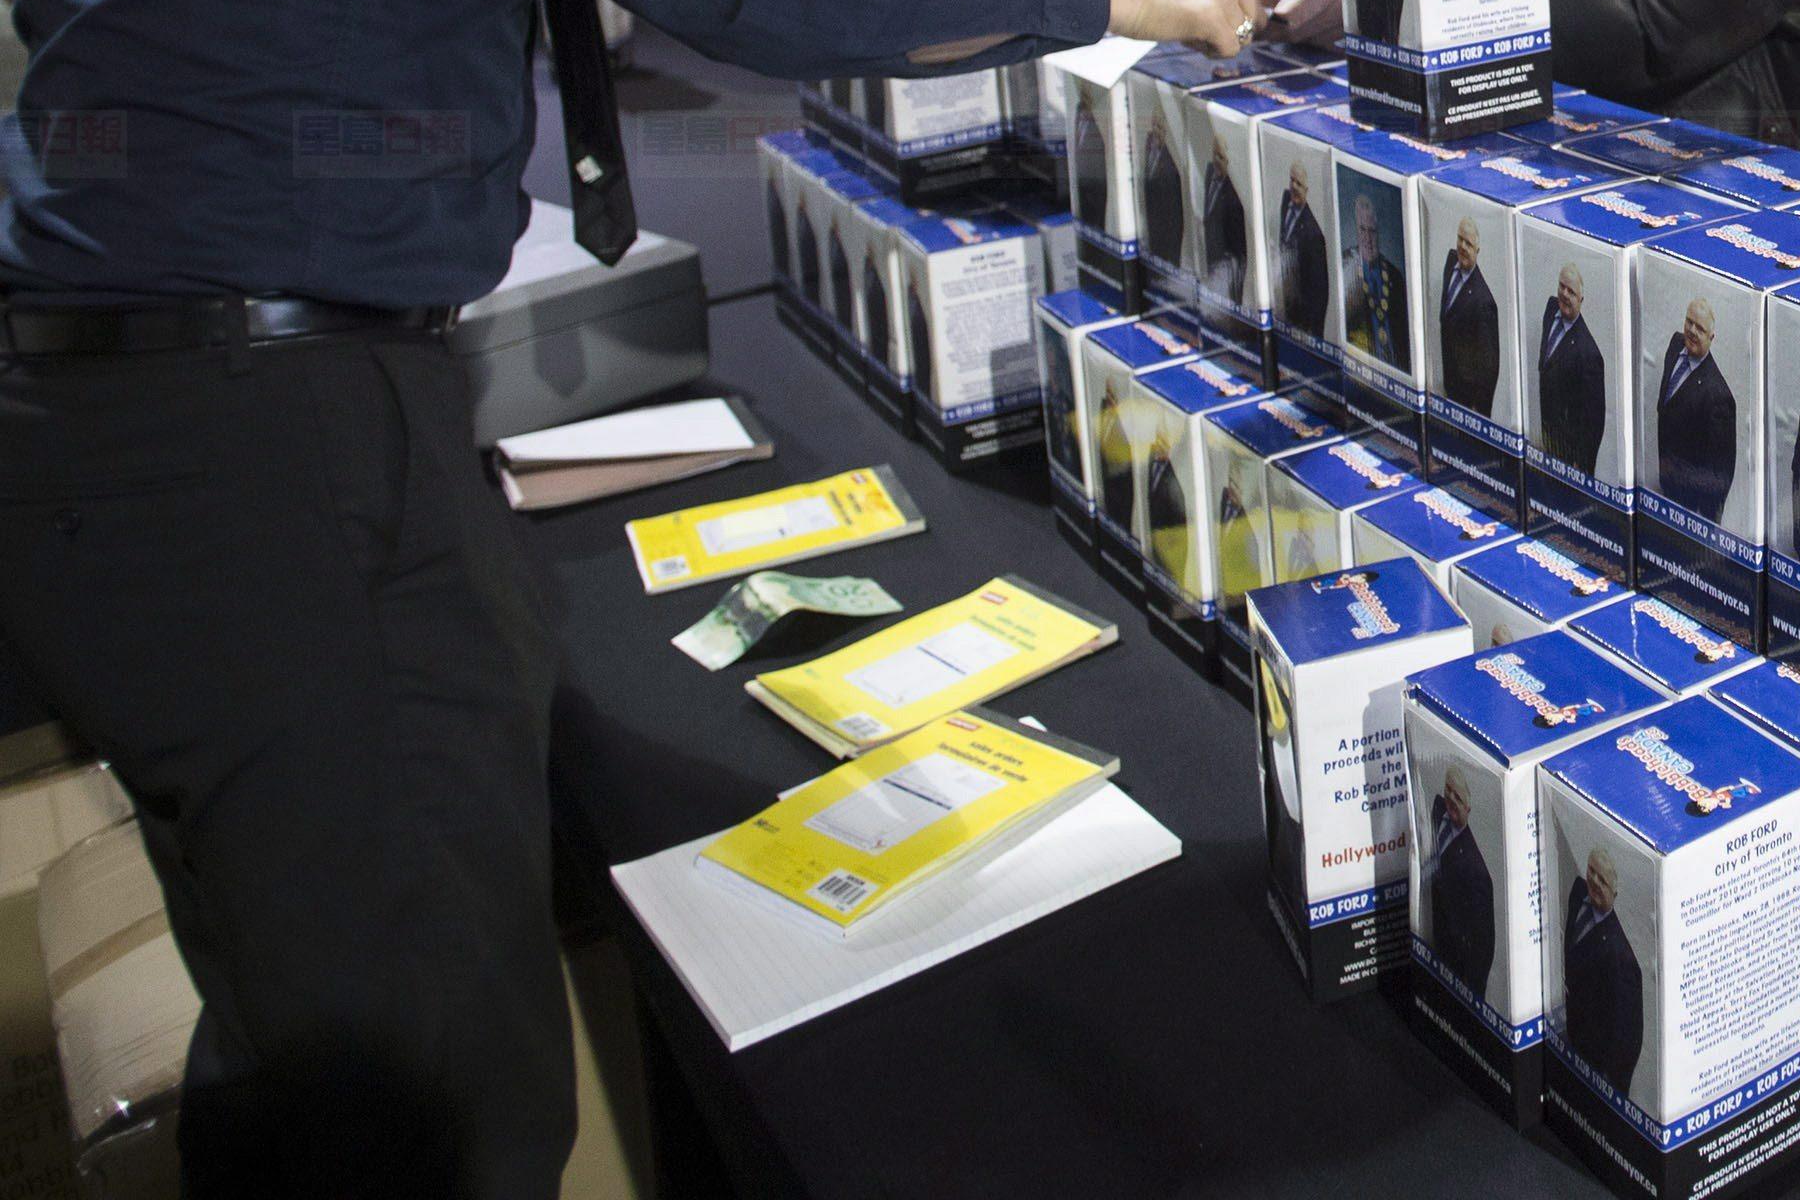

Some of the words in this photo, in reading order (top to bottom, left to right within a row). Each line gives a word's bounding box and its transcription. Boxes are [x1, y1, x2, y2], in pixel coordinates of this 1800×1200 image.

[1440, 49, 1458, 64] ROB
[1460, 45, 1483, 61] FORD
[1494, 39, 1511, 54] ROB
[1513, 34, 1534, 51] FORD
[1640, 493, 1659, 512] FORD
[1669, 508, 1685, 526] ROB
[1688, 518, 1708, 539] FORD
[1719, 534, 1736, 553] ROB
[1739, 546, 1762, 565] FORD
[1642, 547, 1750, 616] www.robfordformayor.ca
[1772, 556, 1793, 579] FORD
[1339, 739, 1347, 751] A
[1353, 728, 1399, 751] portion
[1324, 748, 1382, 774] proceeds
[1382, 761, 1401, 774] the
[1335, 787, 1359, 803] Rob
[1363, 778, 1390, 795] Ford
[1322, 832, 1406, 868] Hollywood
[1726, 833, 1747, 855] ROB
[1751, 818, 1777, 843] FORD
[1714, 856, 1736, 879] City
[1740, 849, 1750, 866] of
[1754, 827, 1792, 859] Toronto
[1310, 902, 1334, 921] ROB
[1338, 893, 1368, 914] FORD
[1756, 1068, 1778, 1095] ROB
[1687, 1106, 1710, 1134] ROB
[1713, 1089, 1742, 1120] FORD
[1699, 1138, 1717, 1157] THIS
[1718, 1116, 1755, 1146] PRODUCT
[1757, 1111, 1764, 1124] IS
[1765, 1101, 1781, 1119] NOT
[1782, 1097, 1788, 1109] A
[1708, 1144, 1724, 1163] FOR
[1726, 1125, 1757, 1152] DISPLAY
[1759, 1116, 1773, 1133] USE
[1775, 1103, 1795, 1124] ONLY.
